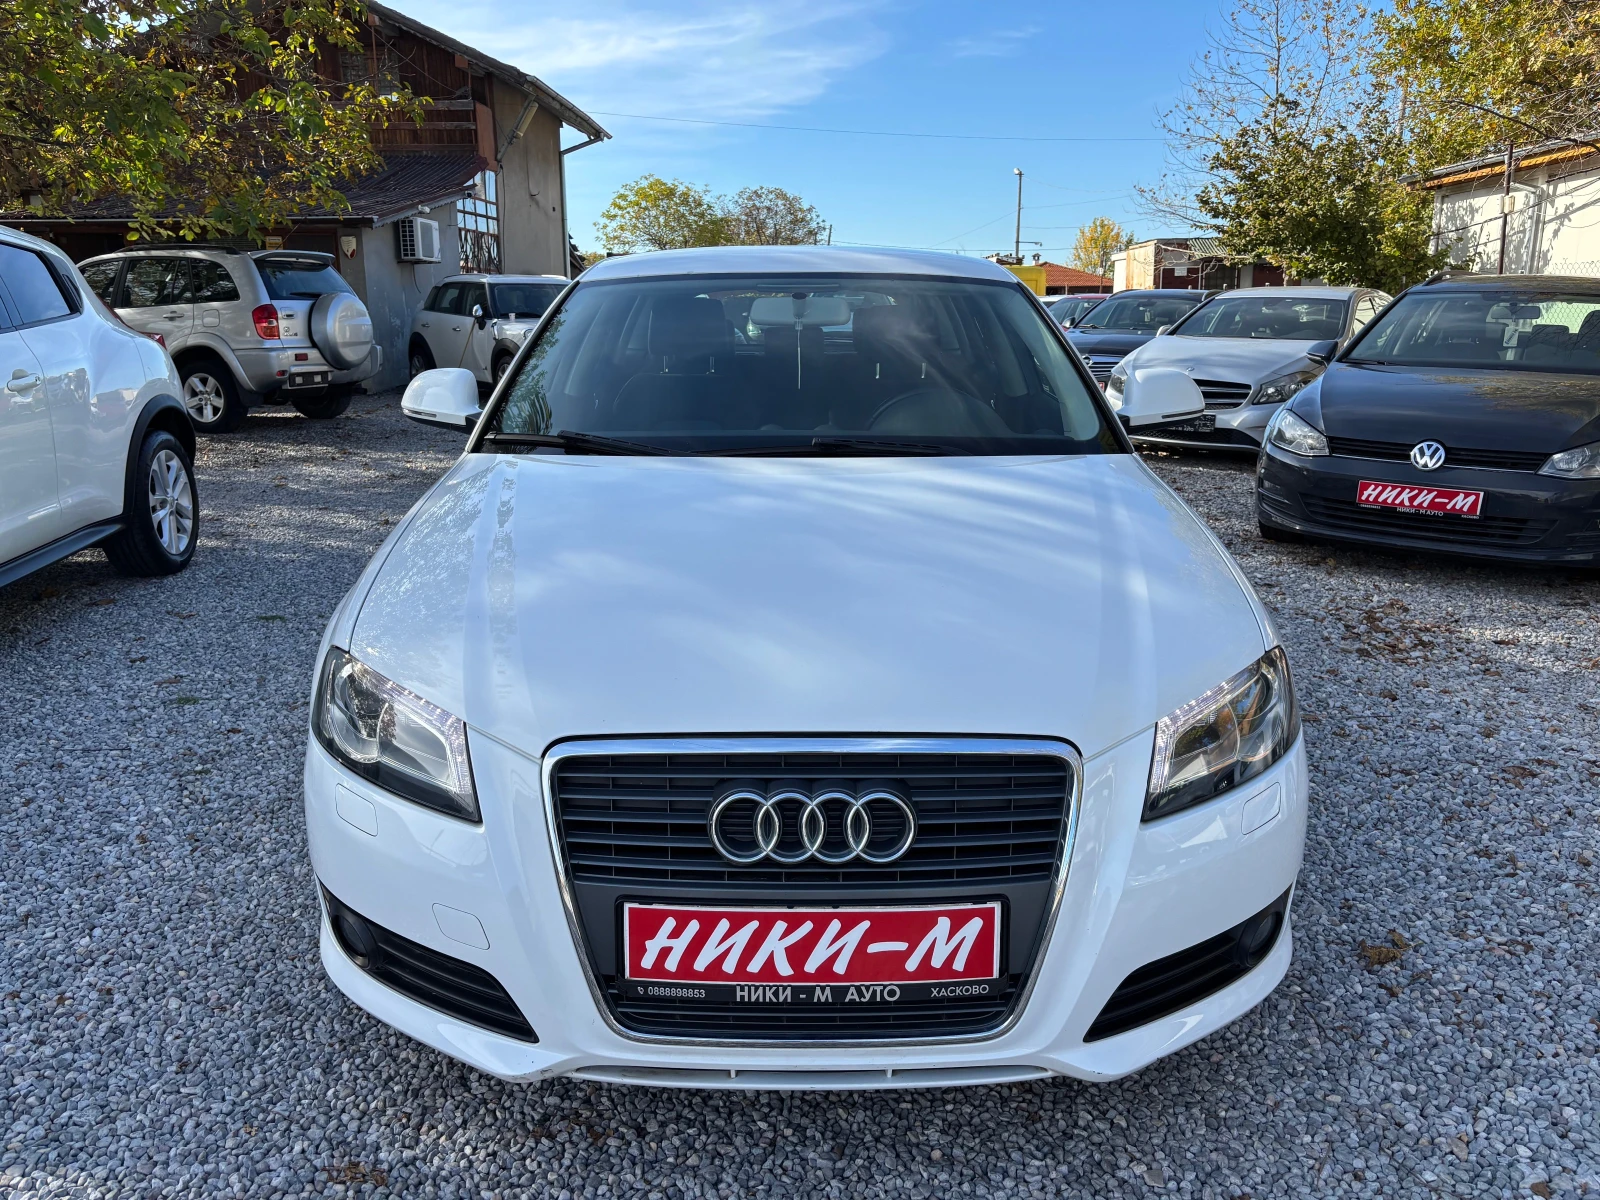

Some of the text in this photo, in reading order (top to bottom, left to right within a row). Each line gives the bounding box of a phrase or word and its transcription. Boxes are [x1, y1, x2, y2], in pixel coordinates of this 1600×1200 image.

[1361, 484, 1476, 512] НИКИ-М
[640, 916, 984, 977] НИКИ-М
[647, 986, 706, 998] 0888898853
[736, 985, 792, 1003] НИКИ
[814, 986, 832, 1003] М
[845, 985, 901, 1002] АУТО
[930, 984, 990, 998] ХАСКОВО
